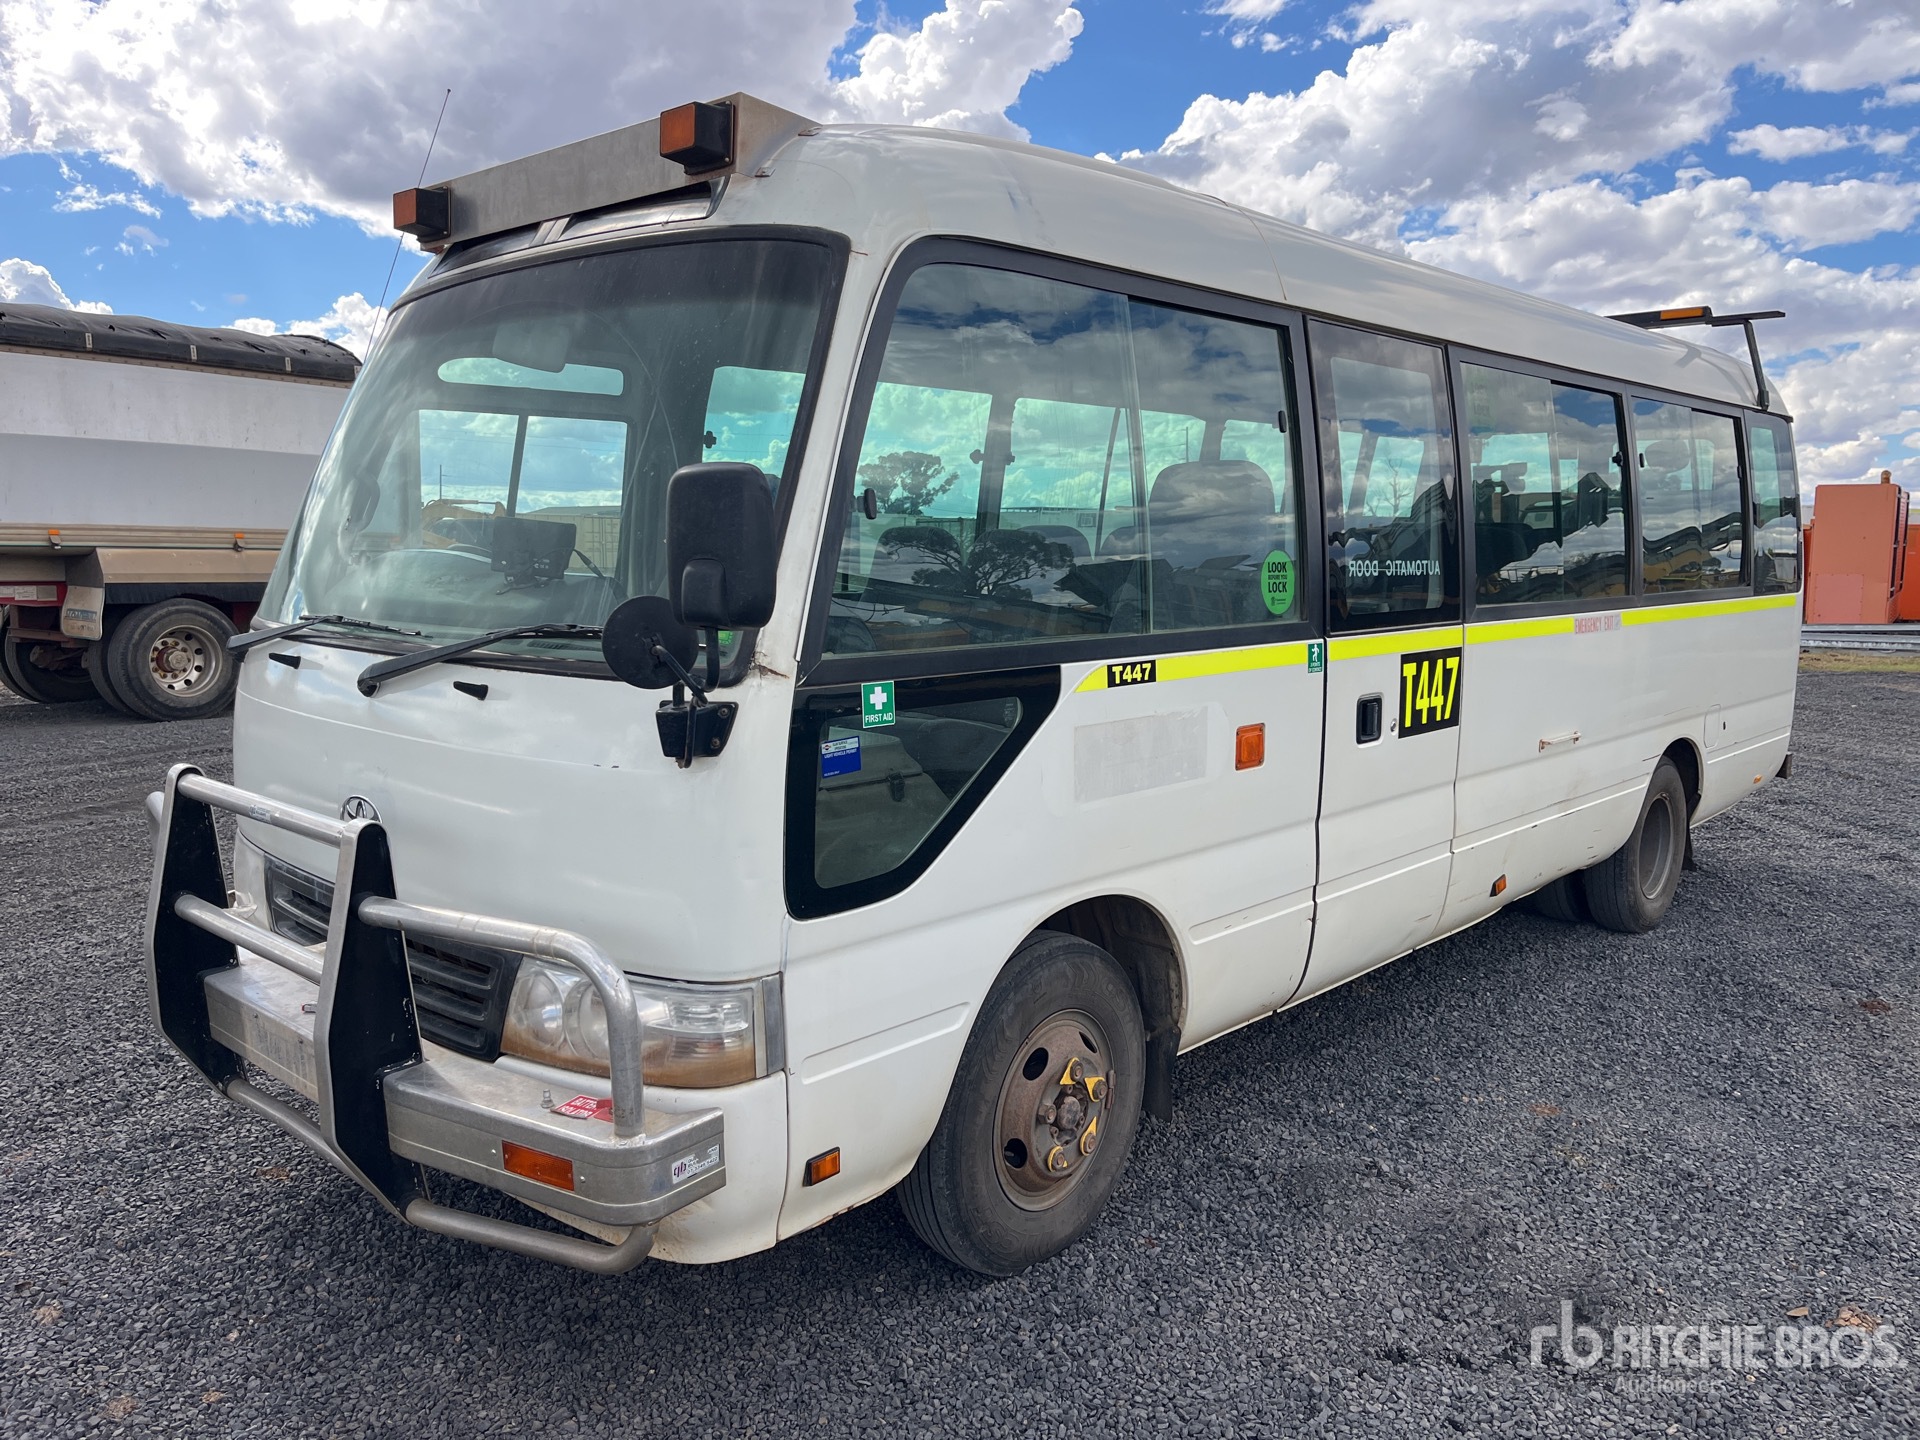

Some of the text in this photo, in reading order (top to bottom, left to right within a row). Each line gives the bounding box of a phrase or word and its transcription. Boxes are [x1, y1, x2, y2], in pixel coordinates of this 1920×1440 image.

[1267, 561, 1287, 573] LOOK
[1267, 581, 1288, 593] LOCK
[1112, 662, 1152, 685] T447
[1403, 656, 1460, 728] T447
[865, 712, 894, 723] FIRST AID
